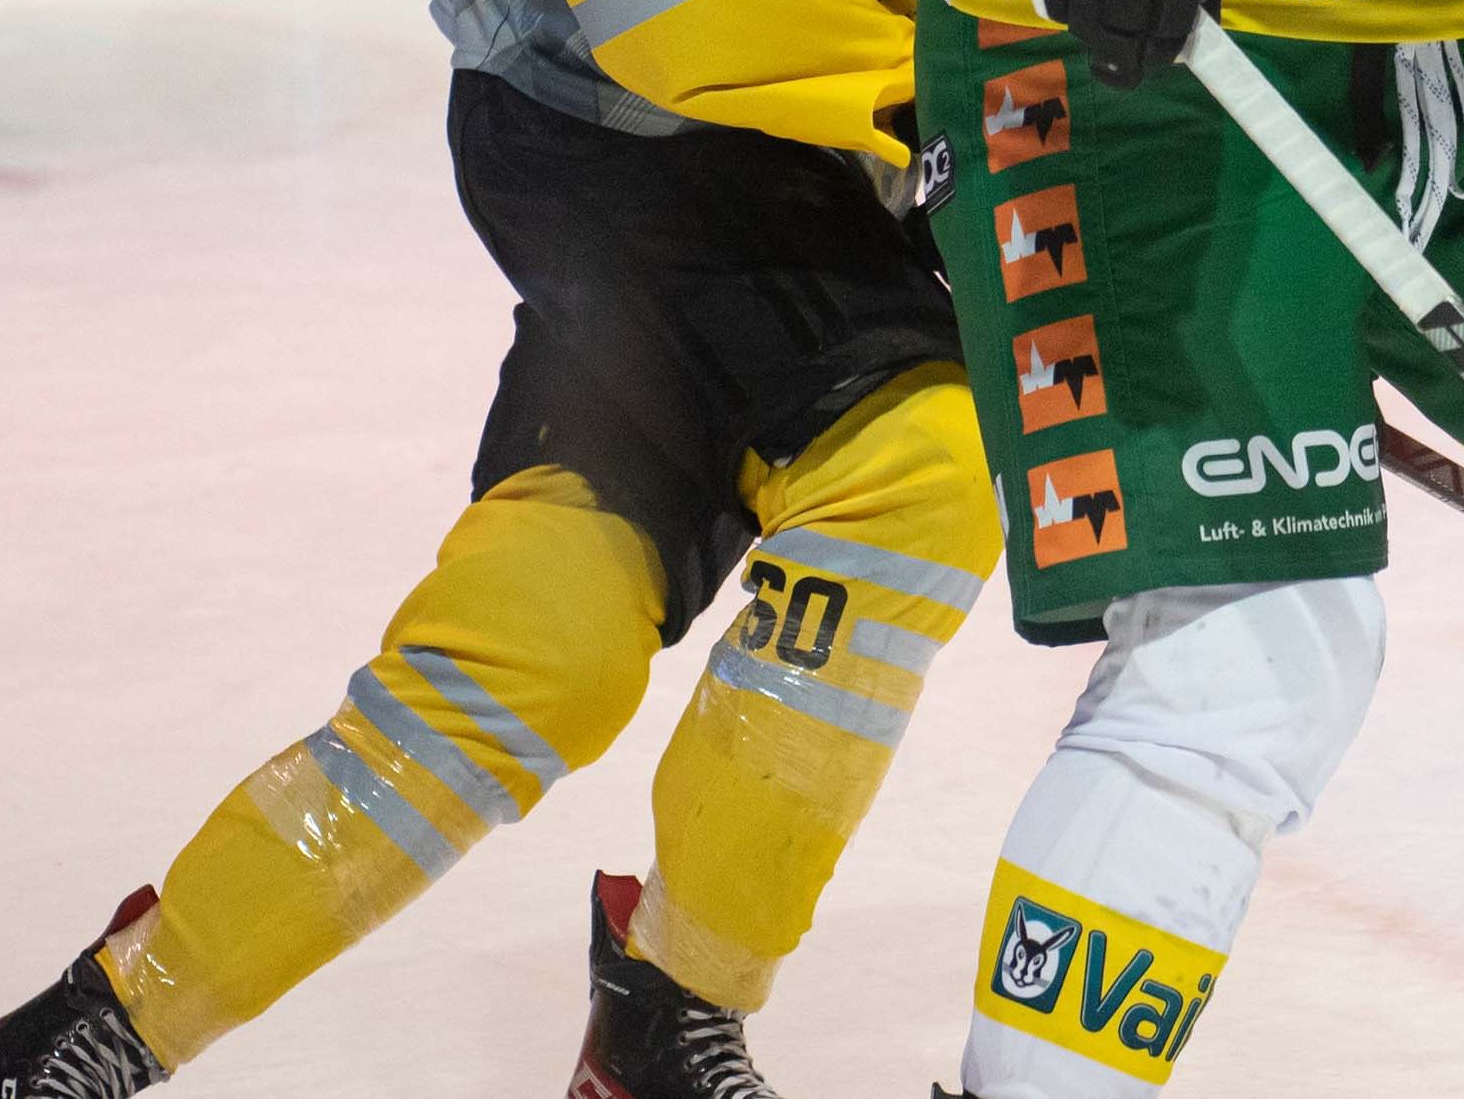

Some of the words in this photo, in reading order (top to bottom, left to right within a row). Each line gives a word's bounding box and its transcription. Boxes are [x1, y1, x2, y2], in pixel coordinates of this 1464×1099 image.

[1200, 521, 1245, 542] Luft-
[1252, 520, 1267, 538] &
[1272, 508, 1374, 536] Klimatechnik
[740, 560, 848, 670] 60
